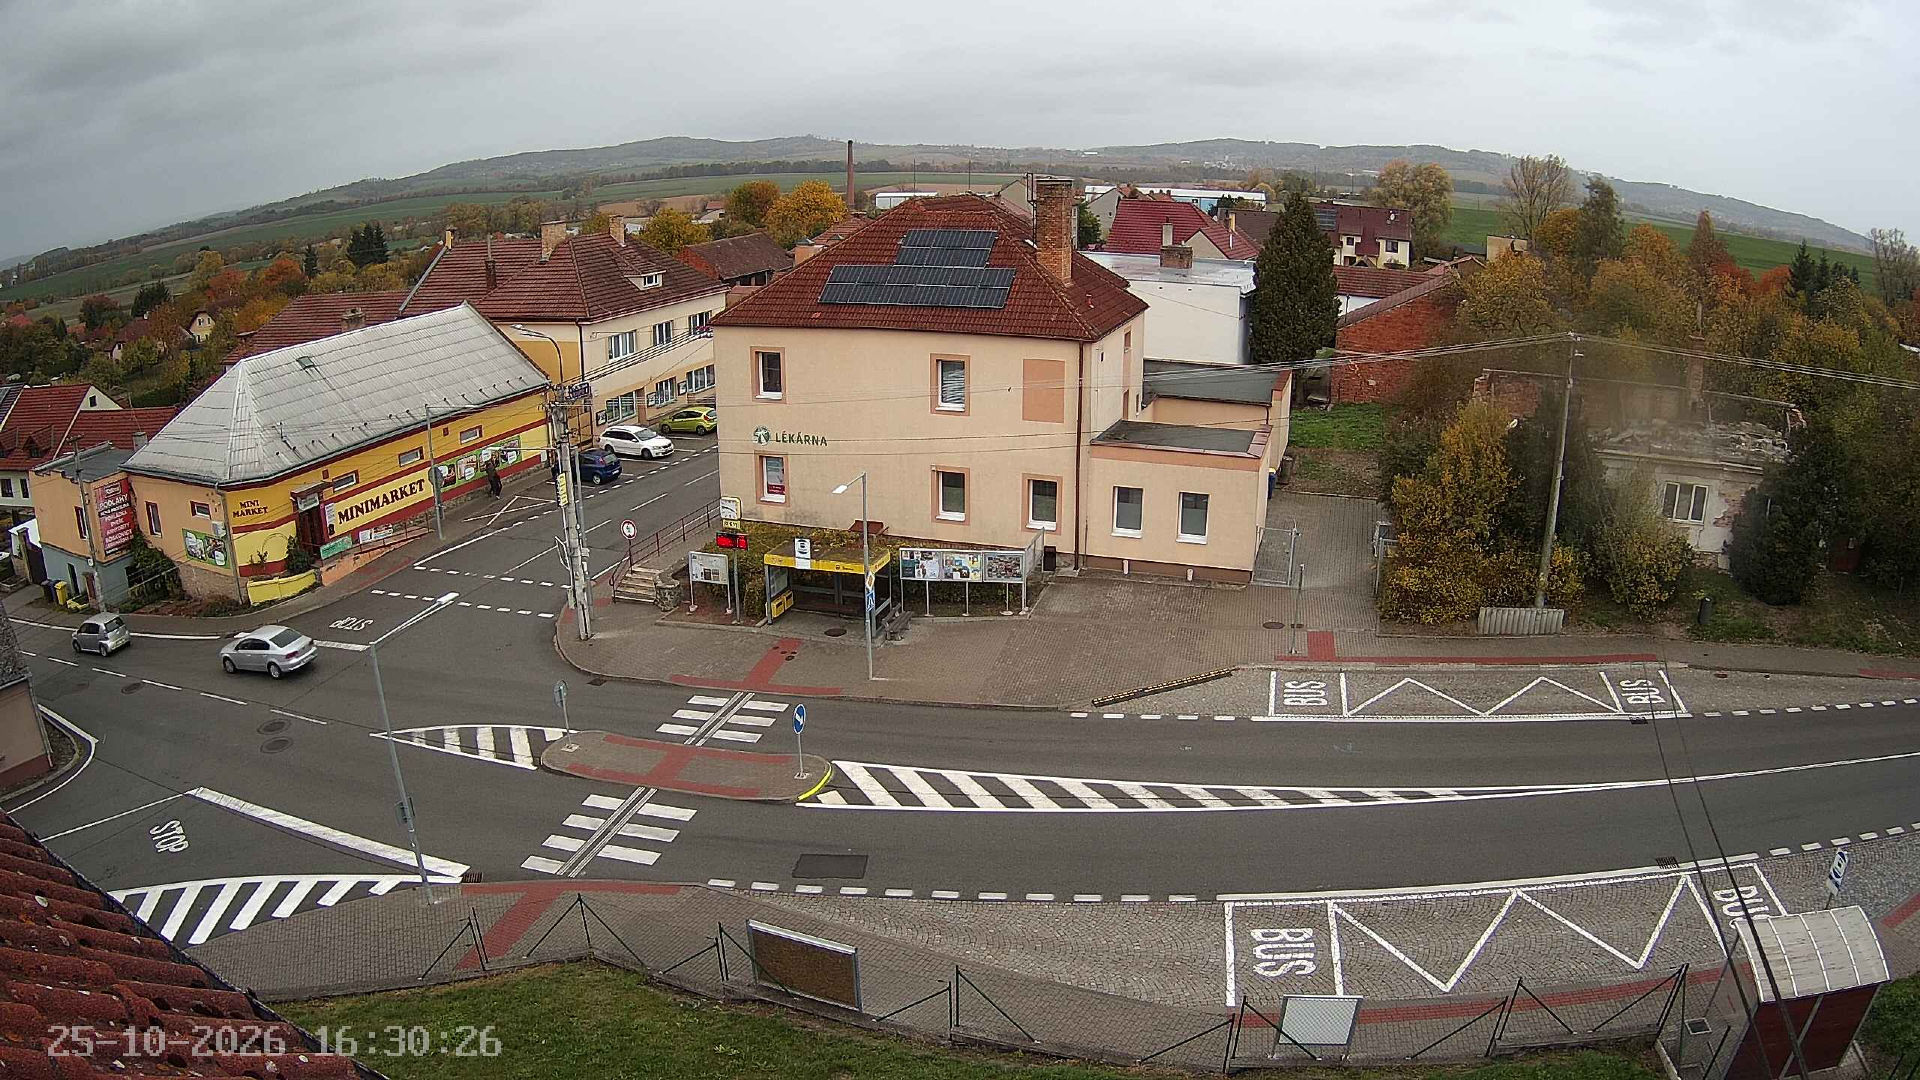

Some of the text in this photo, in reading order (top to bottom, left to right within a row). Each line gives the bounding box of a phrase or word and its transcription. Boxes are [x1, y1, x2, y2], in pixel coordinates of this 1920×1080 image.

[775, 430, 828, 447] LÉKÁRNA
[99, 493, 129, 511] PODLAHY
[232, 506, 269, 518] MARKET
[239, 499, 260, 509] MINI
[337, 478, 426, 525] MINIMARKET
[328, 616, 374, 631] STOP
[1283, 679, 1328, 708] BUS
[1619, 678, 1666, 705] BUS
[149, 819, 189, 854] STOP
[1250, 927, 1316, 979] BUS
